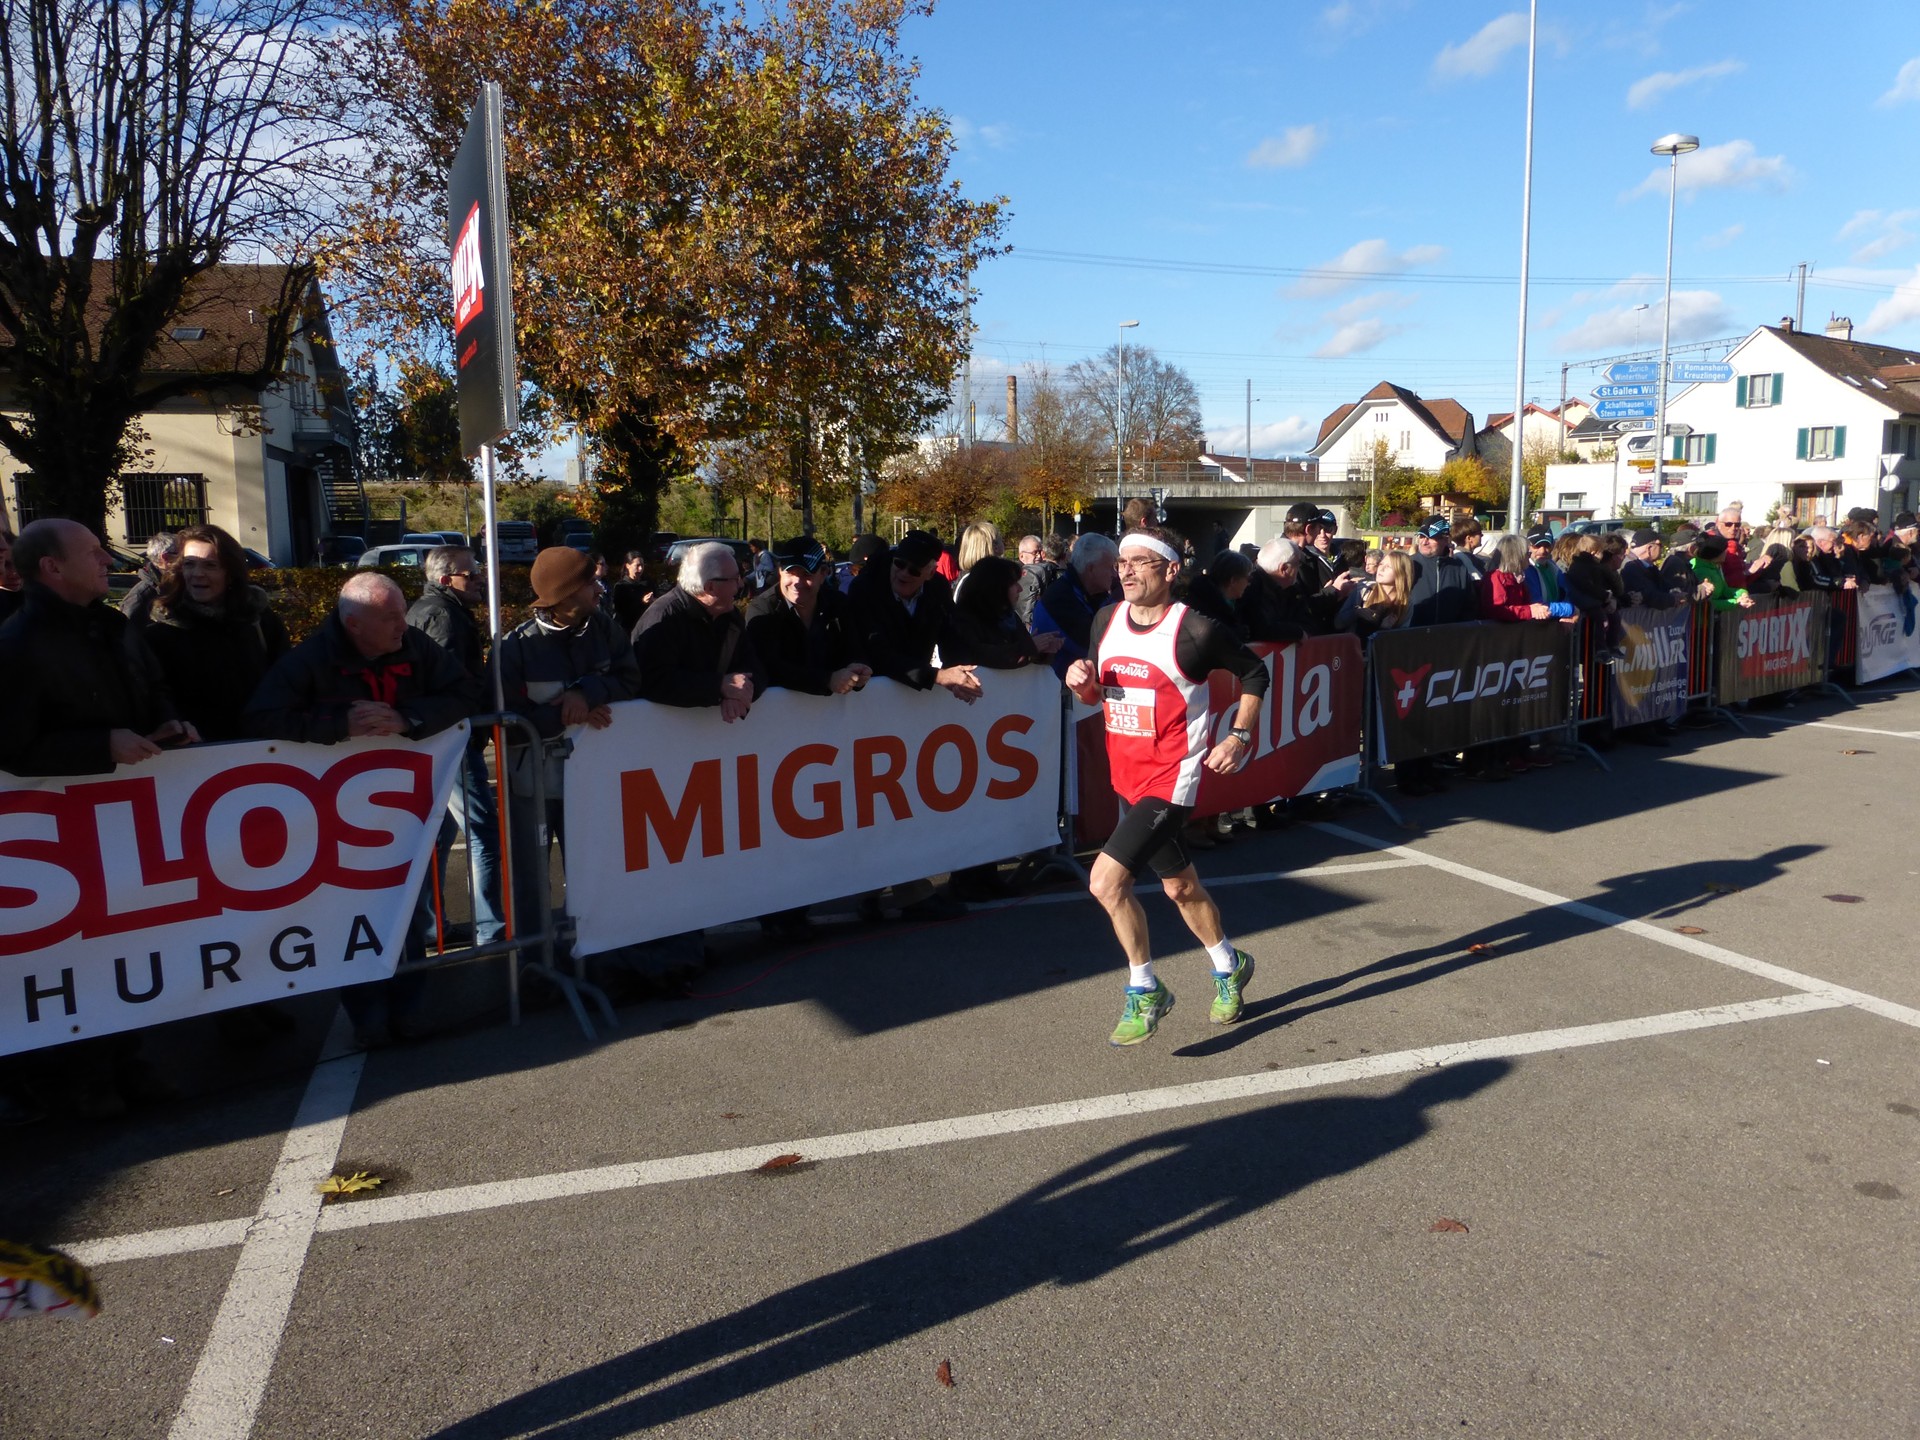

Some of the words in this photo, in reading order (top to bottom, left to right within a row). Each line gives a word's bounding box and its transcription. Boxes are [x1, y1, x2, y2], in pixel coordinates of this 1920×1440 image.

[1684, 364, 1729, 372] Romanshorn
[1683, 371, 1726, 381] Kreuzlingen
[1640, 385, 1655, 394] Wil
[1604, 401, 1645, 410] Schaffhausen
[1627, 408, 1645, 417] Rhein
[1110, 663, 1149, 679] GRAVAG
[1425, 654, 1554, 708] CUORE
[1109, 703, 1139, 716] FELIX
[1110, 713, 1139, 729] 2153
[620, 713, 1040, 873] MIGROS
